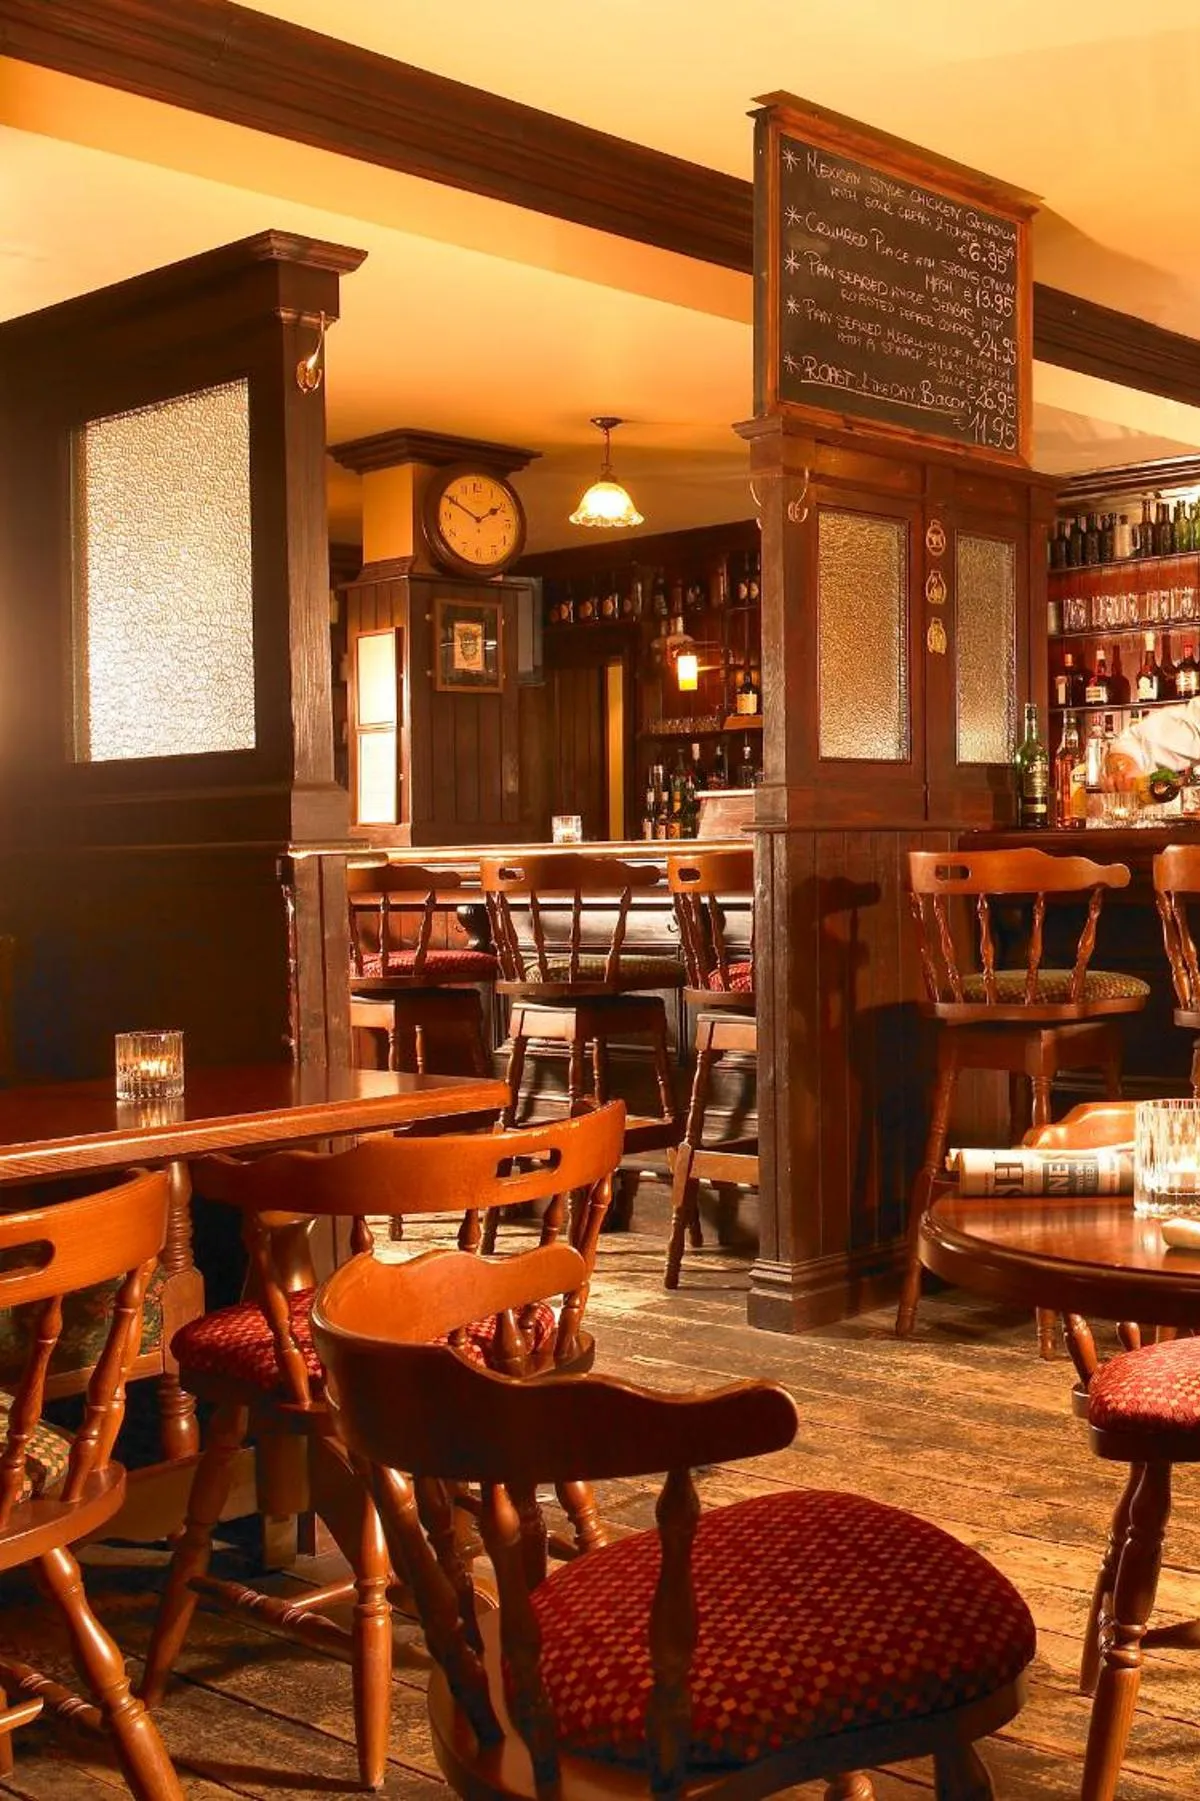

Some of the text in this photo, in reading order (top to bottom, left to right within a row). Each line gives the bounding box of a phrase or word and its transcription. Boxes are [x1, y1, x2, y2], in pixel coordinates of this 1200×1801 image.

[909, 189, 962, 221] CHICKEN
[957, 242, 1007, 274] €6.95
[838, 269, 889, 296] SEARED
[840, 288, 895, 313] ROASTED
[963, 286, 1015, 318] €13.95
[837, 315, 881, 337] SEARED
[801, 355, 858, 388] ROAST
